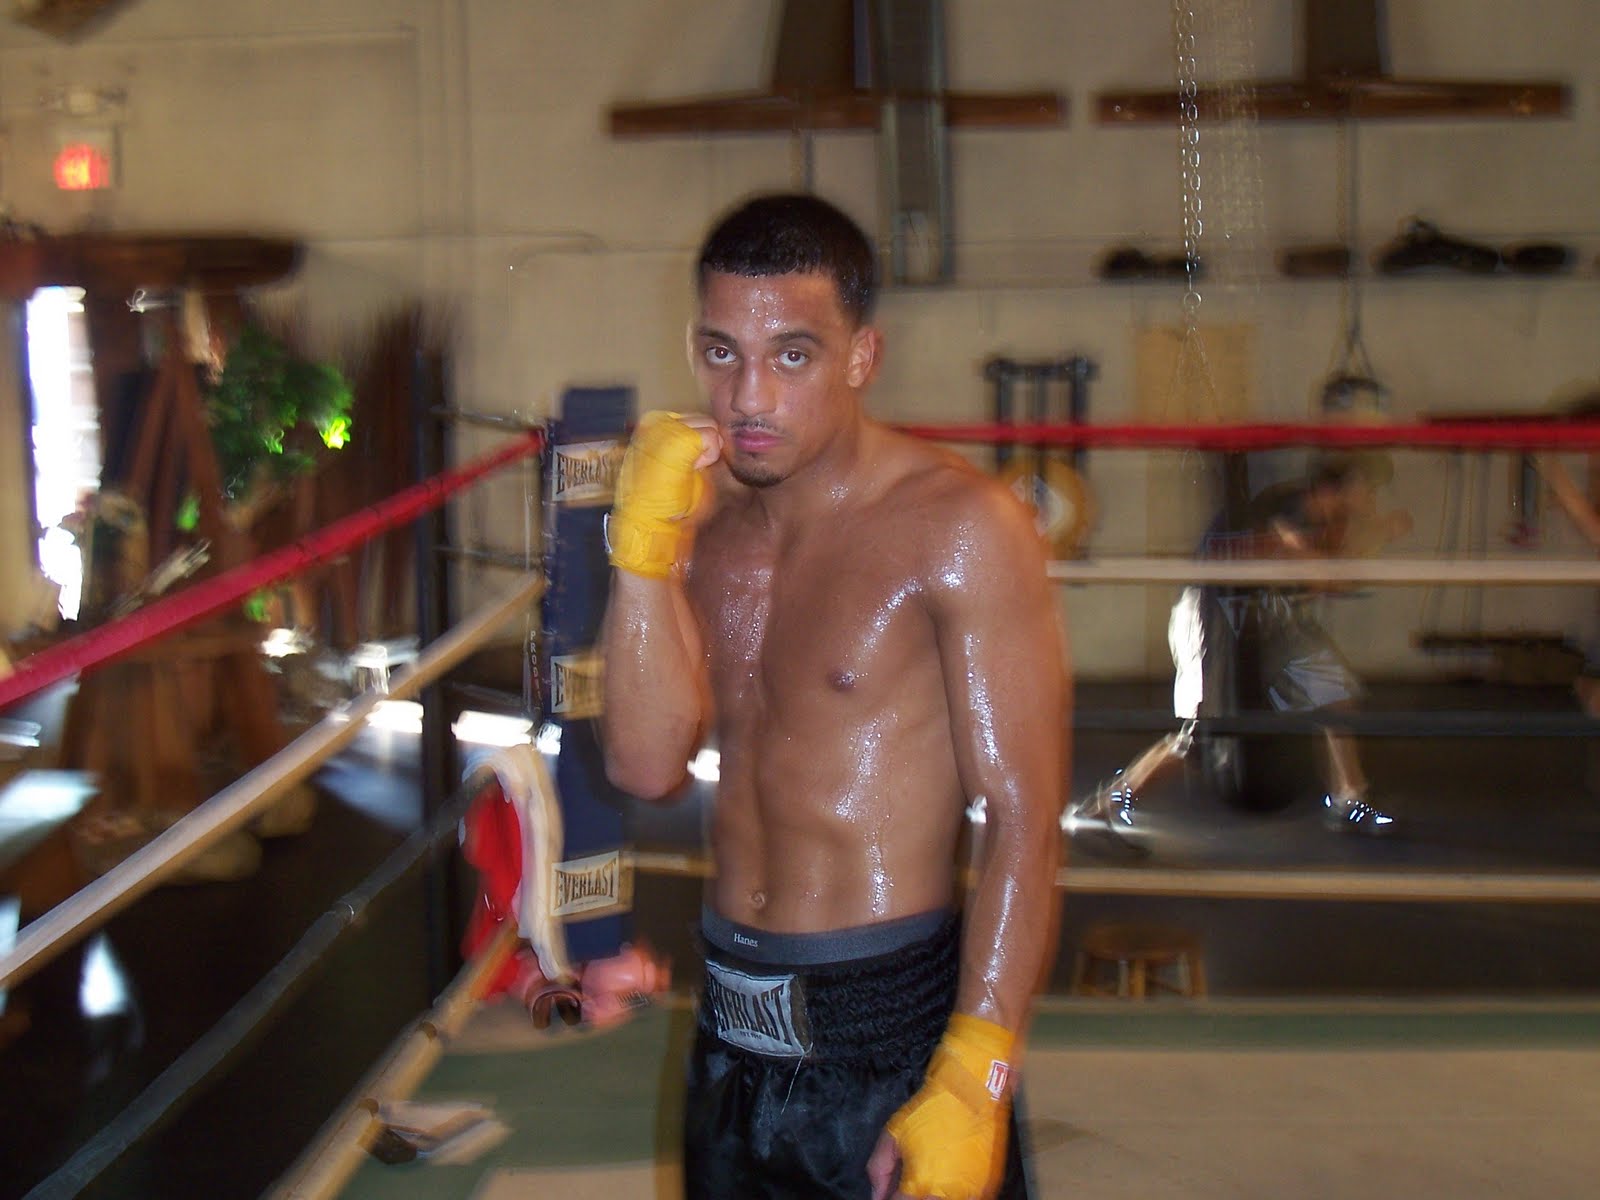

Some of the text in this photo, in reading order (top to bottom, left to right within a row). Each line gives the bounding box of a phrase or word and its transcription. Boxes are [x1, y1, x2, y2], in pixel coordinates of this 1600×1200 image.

[554, 857, 617, 911] EVERLAST
[734, 932, 759, 948] Hanes
[709, 971, 793, 1046] EVERLAST
